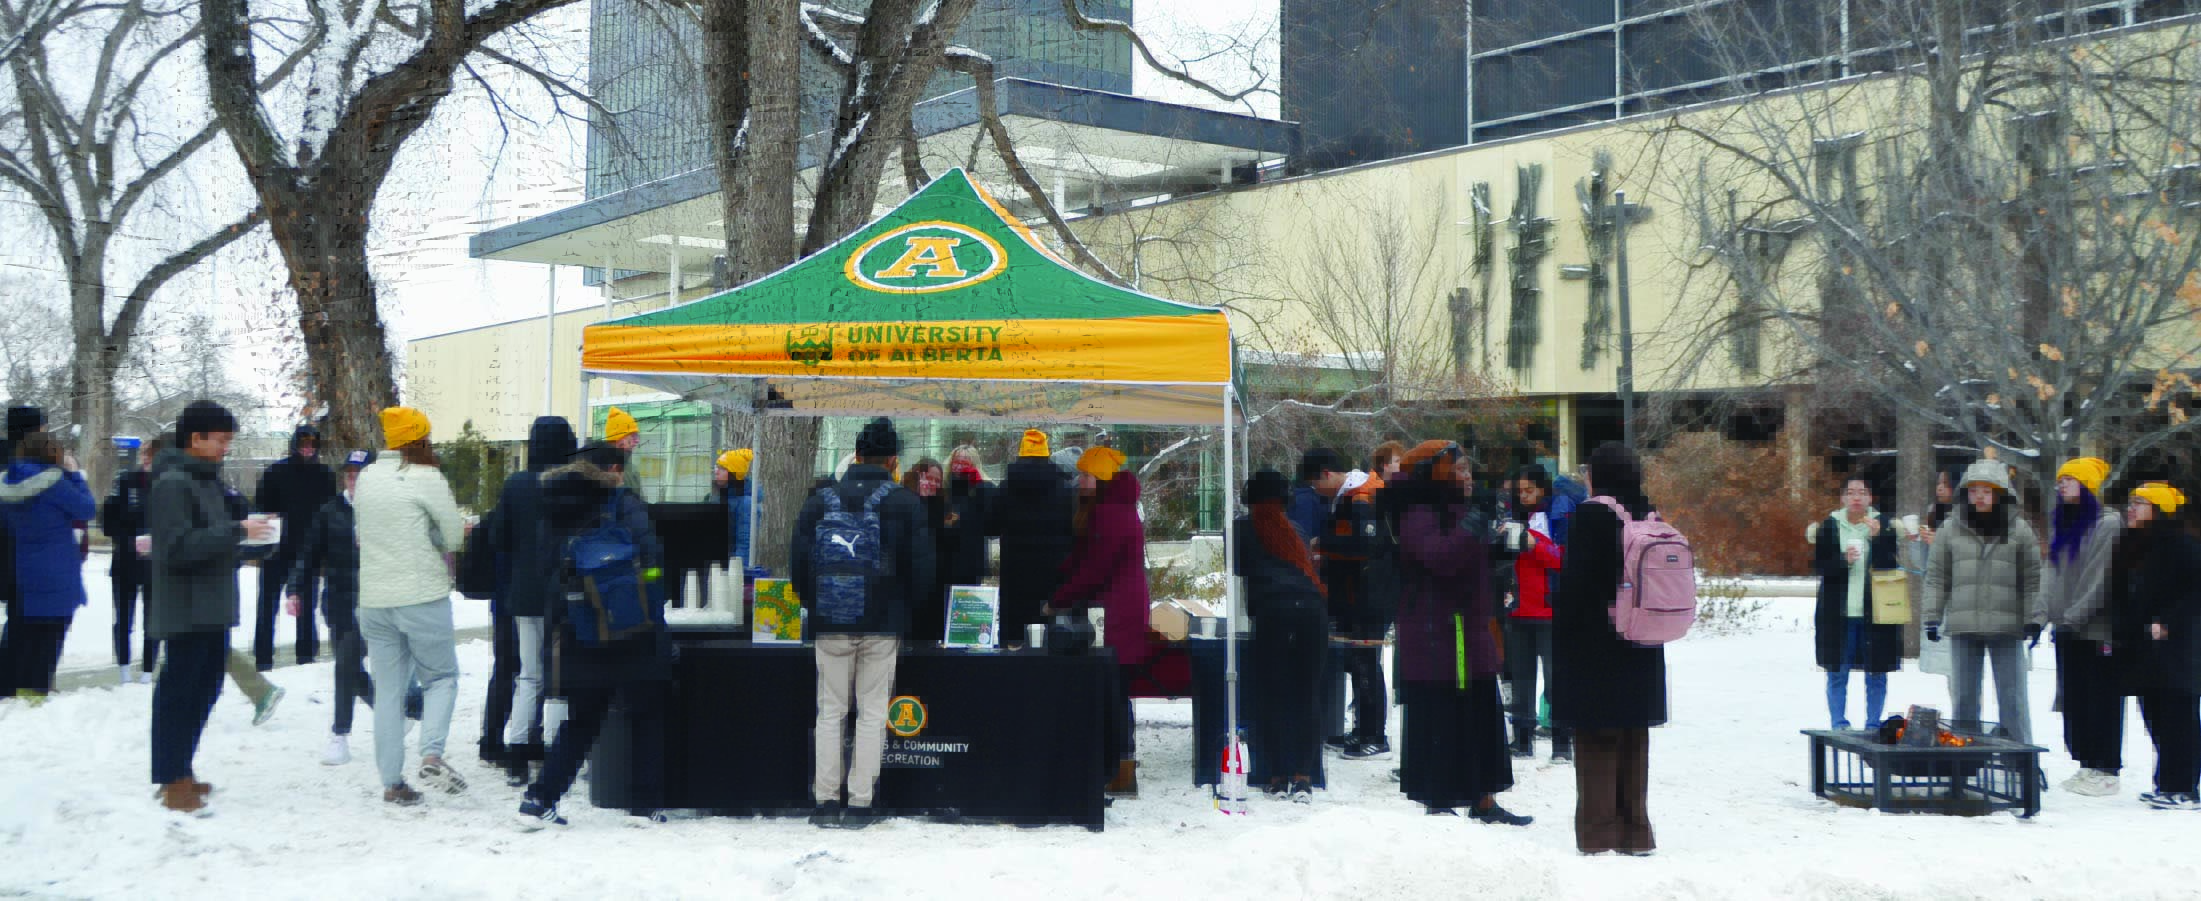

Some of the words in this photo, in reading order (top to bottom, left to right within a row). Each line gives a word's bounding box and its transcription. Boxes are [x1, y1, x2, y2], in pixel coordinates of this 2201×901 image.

[874, 236, 968, 279] A
[847, 325, 1003, 344] UNIVERSITY
[848, 347, 881, 362] OF
[889, 346, 1004, 362] ALBERTA
[894, 702, 918, 727] A
[892, 739, 901, 750] &
[903, 739, 969, 753] COMMUNITY
[880, 753, 940, 766] ECREATION
